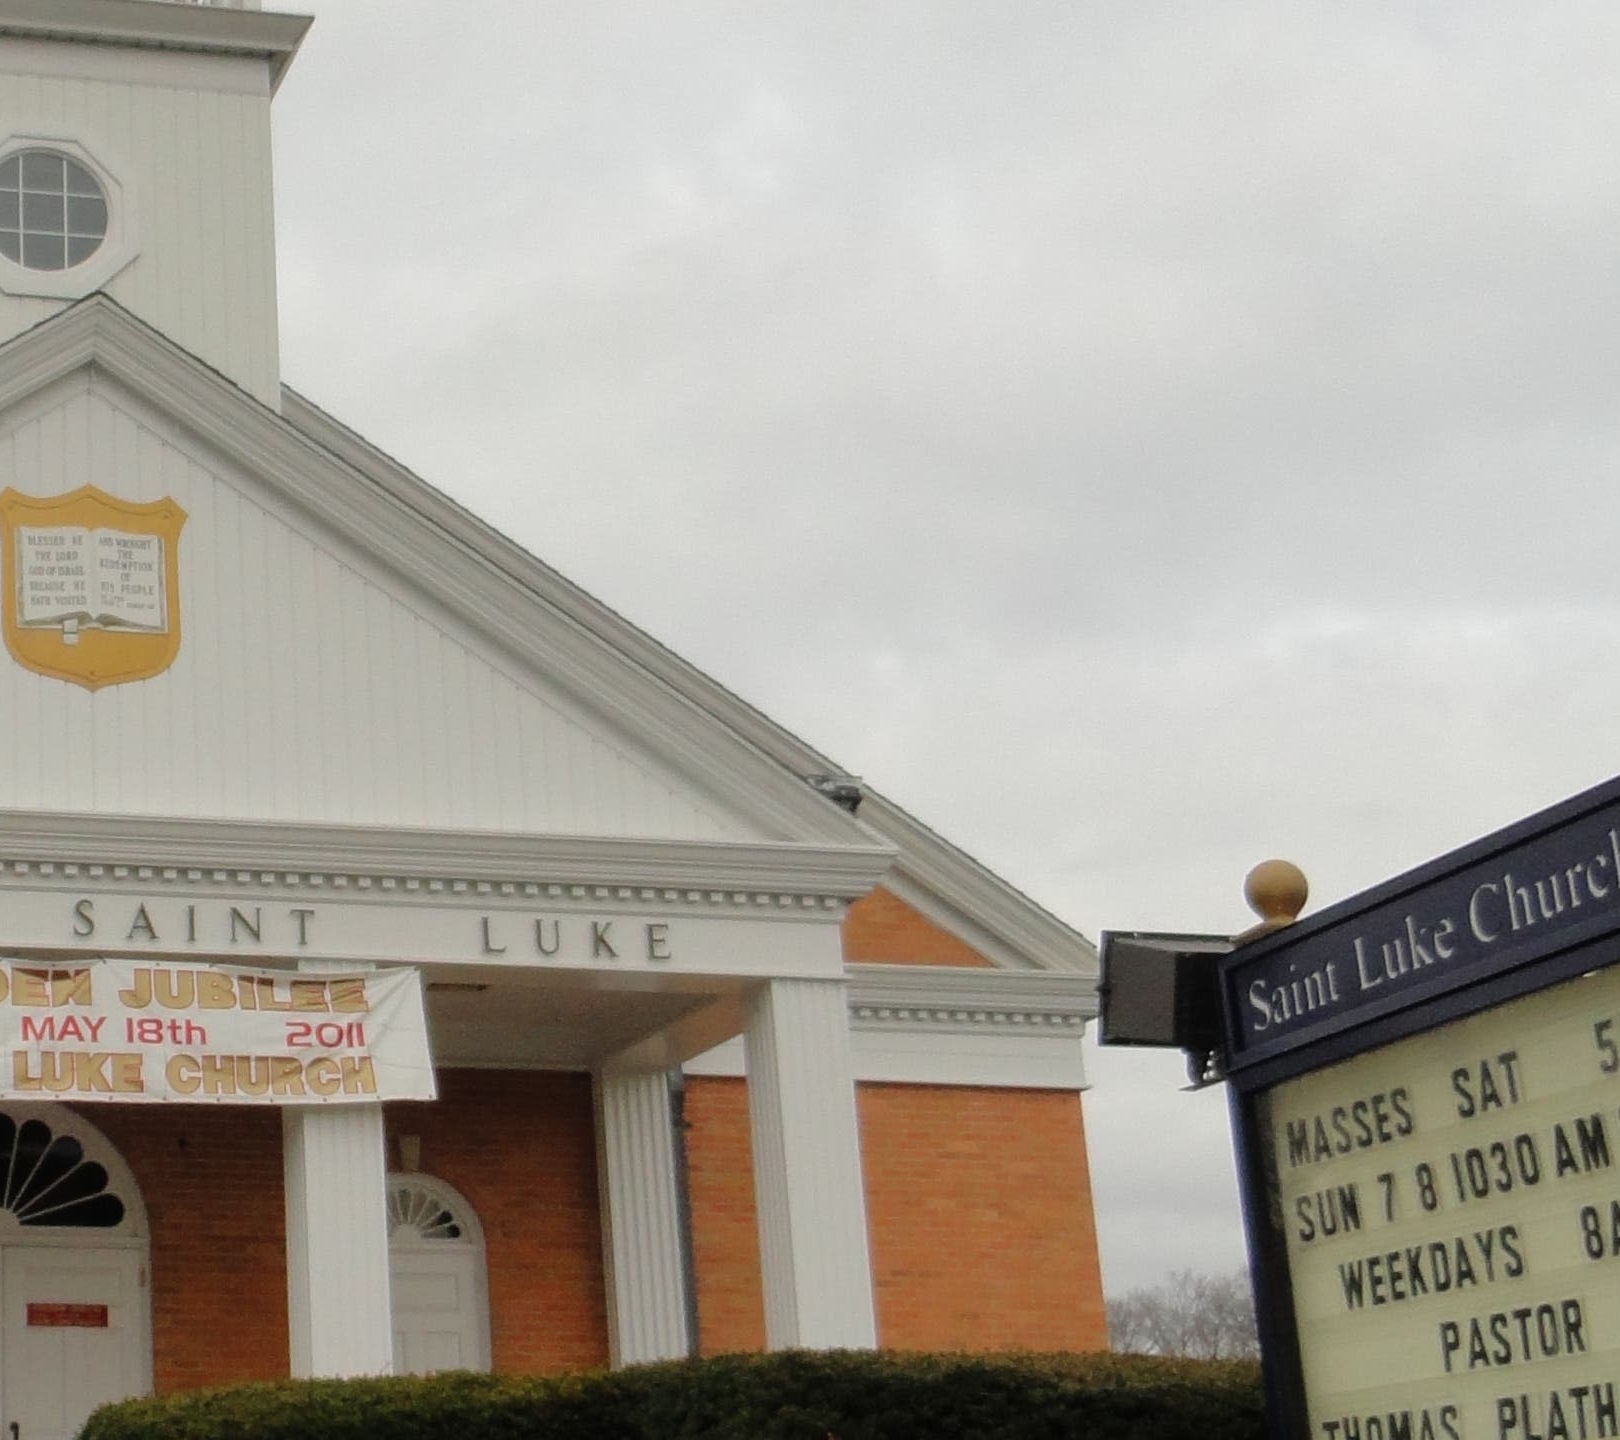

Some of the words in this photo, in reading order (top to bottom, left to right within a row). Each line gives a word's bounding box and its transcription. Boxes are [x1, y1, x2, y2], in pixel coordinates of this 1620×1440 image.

[55, 551, 79, 562] LORD
[117, 549, 134, 561] THE
[120, 583, 155, 596] PEOPLE
[72, 899, 315, 946] SAINT
[482, 916, 672, 960] LUKE
[118, 967, 370, 1013] JUBILEE
[1248, 962, 1340, 1031] Saint
[1353, 915, 1455, 990] Luke
[21, 1015, 107, 1044] MAY
[125, 1017, 208, 1046] 18th
[285, 1021, 365, 1049] 2011
[12, 1050, 145, 1094] LUKE
[165, 1053, 377, 1096] CHURCH
[1286, 1087, 1414, 1168] MASSES
[1452, 1050, 1519, 1119] SAT
[1594, 1019, 1619, 1075] 5
[1294, 1182, 1361, 1243] SUN
[1377, 1172, 1396, 1222] 7
[1415, 1162, 1437, 1212] 8
[1450, 1133, 1540, 1203] 1030
[1553, 1112, 1611, 1179] AM
[1337, 1224, 1525, 1310] WEEKDAYS
[1439, 1298, 1587, 1373] PASTOR
